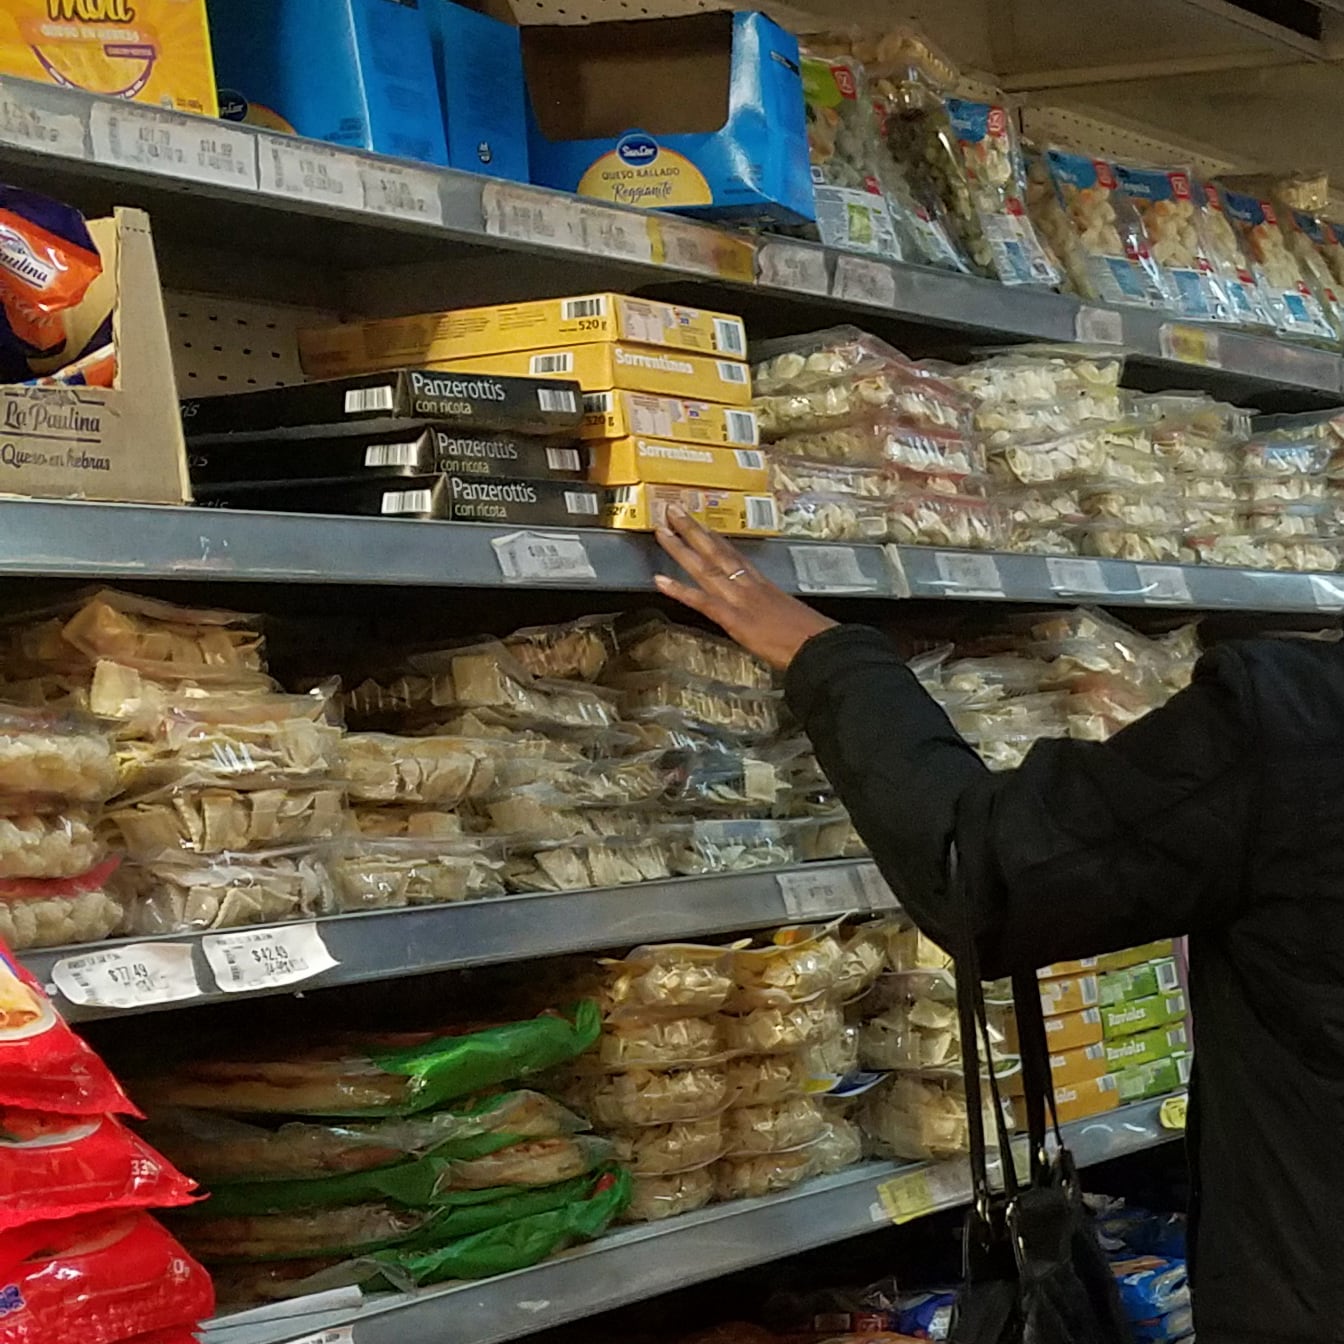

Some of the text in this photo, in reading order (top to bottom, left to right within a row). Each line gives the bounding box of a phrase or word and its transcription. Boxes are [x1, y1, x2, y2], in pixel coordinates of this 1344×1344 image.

[601, 167, 681, 182] QUESO RALLADO
[0, 247, 48, 284] aulina
[578, 319, 600, 332] 520
[615, 349, 693, 375] Sorrentinos
[412, 374, 505, 401] Panzerottis
[4, 401, 101, 433] La Paulina
[415, 400, 473, 416] con ricota
[2, 443, 48, 468] Queso
[66, 448, 111, 471] hebras
[437, 433, 518, 460] Panzerottis
[638, 440, 714, 464] Sorrentinos
[440, 458, 490, 474] con ricota
[451, 477, 537, 503] Panzerottis
[455, 503, 507, 519] con ricota
[107, 962, 149, 984] $77.49
